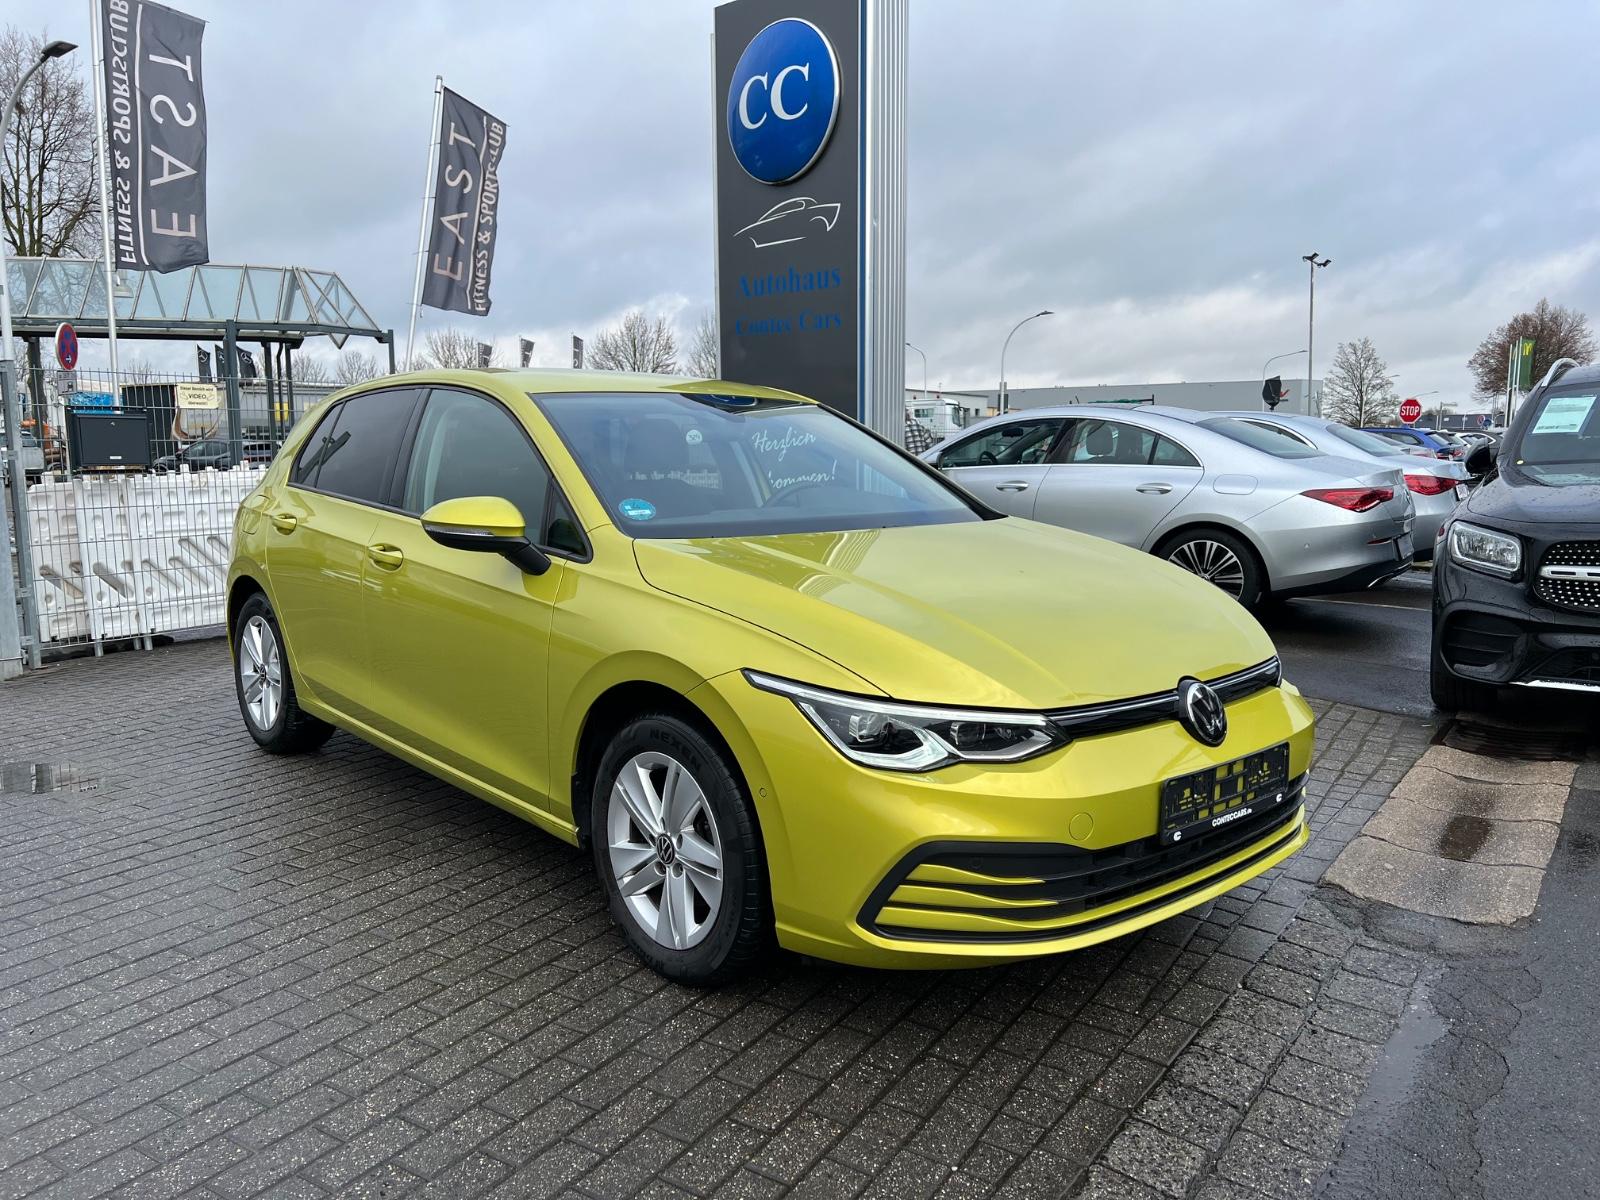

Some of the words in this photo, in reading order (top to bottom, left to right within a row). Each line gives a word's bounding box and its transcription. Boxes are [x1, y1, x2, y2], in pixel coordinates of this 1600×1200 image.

[739, 62, 810, 130] CC
[433, 121, 476, 281] EAST
[477, 230, 492, 244] &
[473, 250, 489, 311] FITNESS
[736, 264, 842, 299] Autohaus
[799, 309, 842, 332] Cars
[1401, 406, 1420, 416] STOP
[768, 459, 837, 489] ommen!
